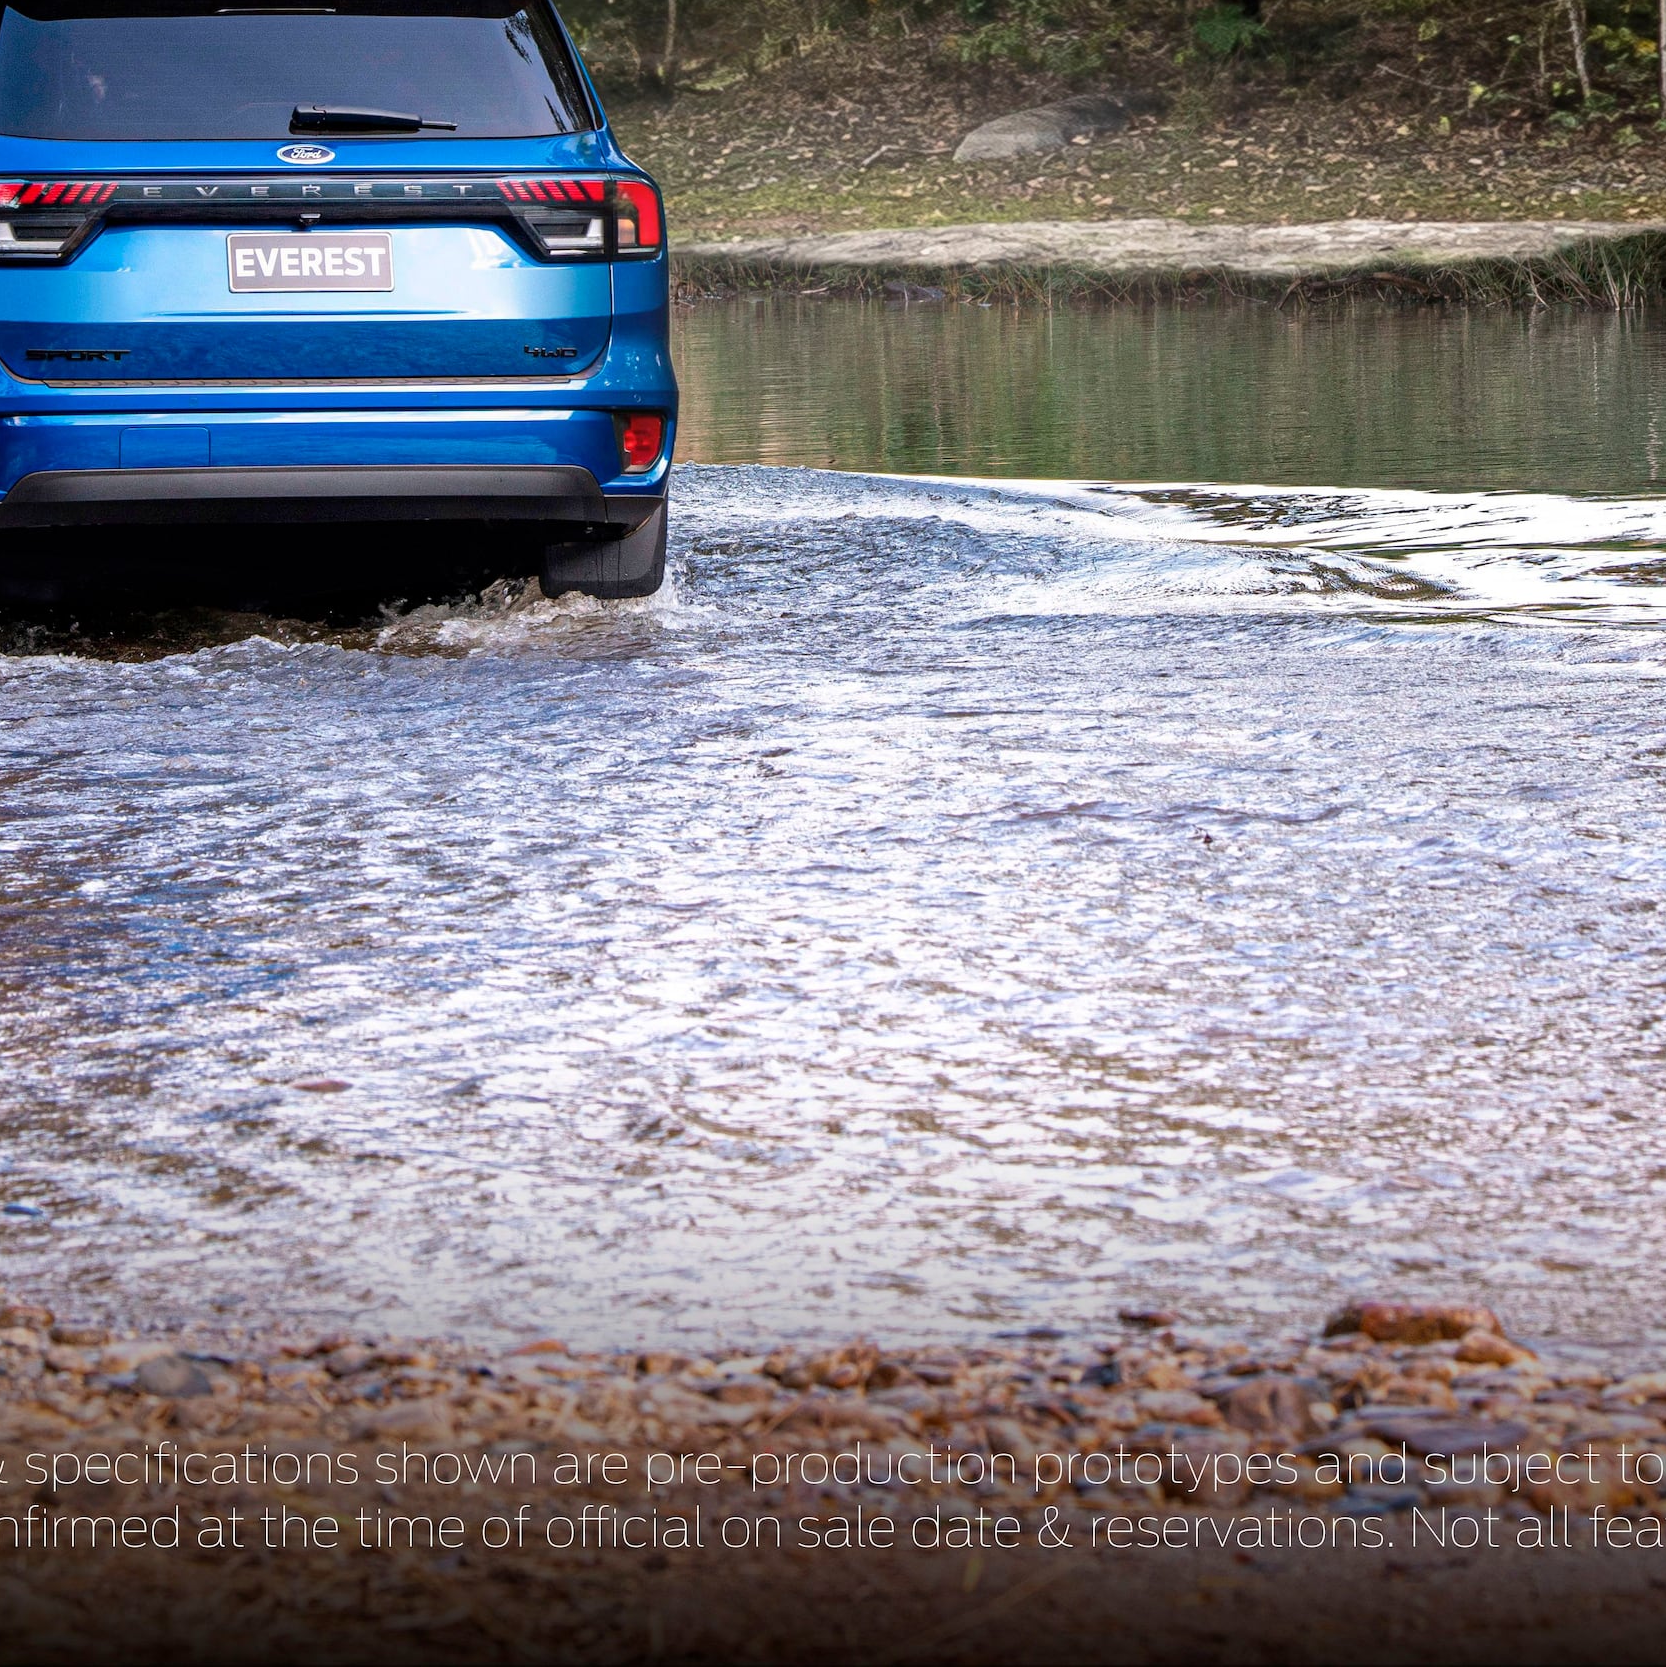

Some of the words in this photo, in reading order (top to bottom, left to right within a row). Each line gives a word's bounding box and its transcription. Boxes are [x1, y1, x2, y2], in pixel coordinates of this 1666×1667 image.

[142, 184, 474, 199] EVEREST
[235, 246, 386, 278] EVEREST
[25, 348, 132, 362] SPORT
[524, 344, 578, 358] 4WD
